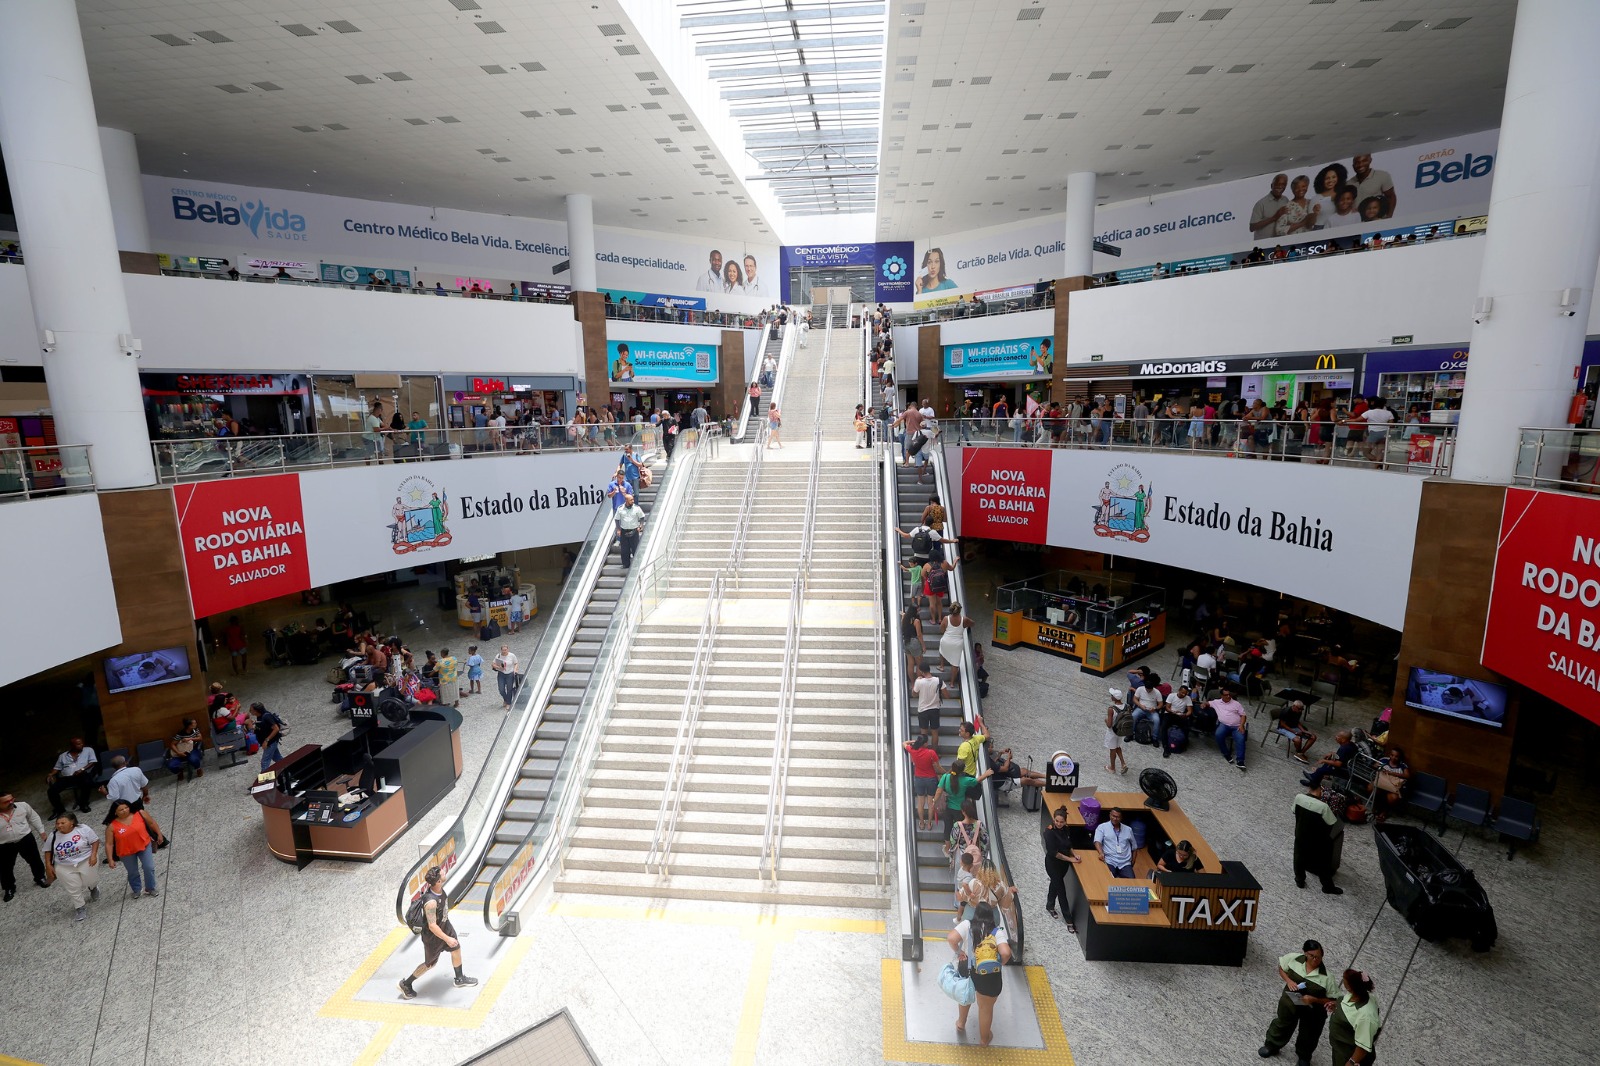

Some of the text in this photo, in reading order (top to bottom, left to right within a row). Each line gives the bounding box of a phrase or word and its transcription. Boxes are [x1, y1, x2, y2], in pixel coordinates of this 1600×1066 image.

[1418, 148, 1455, 162] CARTÃO
[1415, 153, 1494, 189] Bela
[171, 187, 237, 202] CENTRO MÉDICO
[267, 230, 308, 241] SAÚDE
[956, 256, 986, 270] Cartão
[987, 251, 1007, 265] Bela
[1008, 248, 1032, 261] Vida.
[1134, 226, 1151, 237] ao
[1153, 220, 1176, 234] seu
[1178, 211, 1236, 229] alcance.
[343, 219, 395, 236] Centro
[397, 224, 448, 242] Médico
[451, 231, 479, 245] Bela
[481, 234, 513, 249] Vida.
[595, 252, 620, 264] cada
[621, 255, 687, 272] especialidade.
[634, 349, 685, 360] WI-FI GRÁTIS
[968, 344, 1019, 357] WI-FI GRÁTIS
[648, 359, 671, 367] opinião
[980, 355, 1002, 364] opinião
[1140, 360, 1227, 375] McDonald's
[991, 469, 1026, 482] NOVA
[970, 483, 1046, 498] RODOVIÁRIA
[460, 484, 604, 519] Estado da Bahia
[979, 498, 1035, 513] DA BAHIA
[222, 505, 272, 526] NOVA
[987, 514, 1029, 526] SALVADOR
[1163, 495, 1333, 552] Estado da Bahia
[194, 520, 303, 552] RODOVIÁRIA
[213, 541, 292, 570] DA BAHIA
[228, 563, 286, 586] SALVADOR
[1537, 604, 1571, 641] DA
[1038, 625, 1076, 642] LIGHT
[1038, 635, 1054, 644] RENT
[1060, 640, 1074, 648] CAR
[1122, 624, 1150, 646] LIGHT
[1124, 645, 1137, 654] RENT
[1141, 638, 1151, 646] CAR
[1547, 651, 1600, 693] SALVA
[1050, 775, 1076, 786] TAXI
[1171, 897, 1256, 927] TAXI
